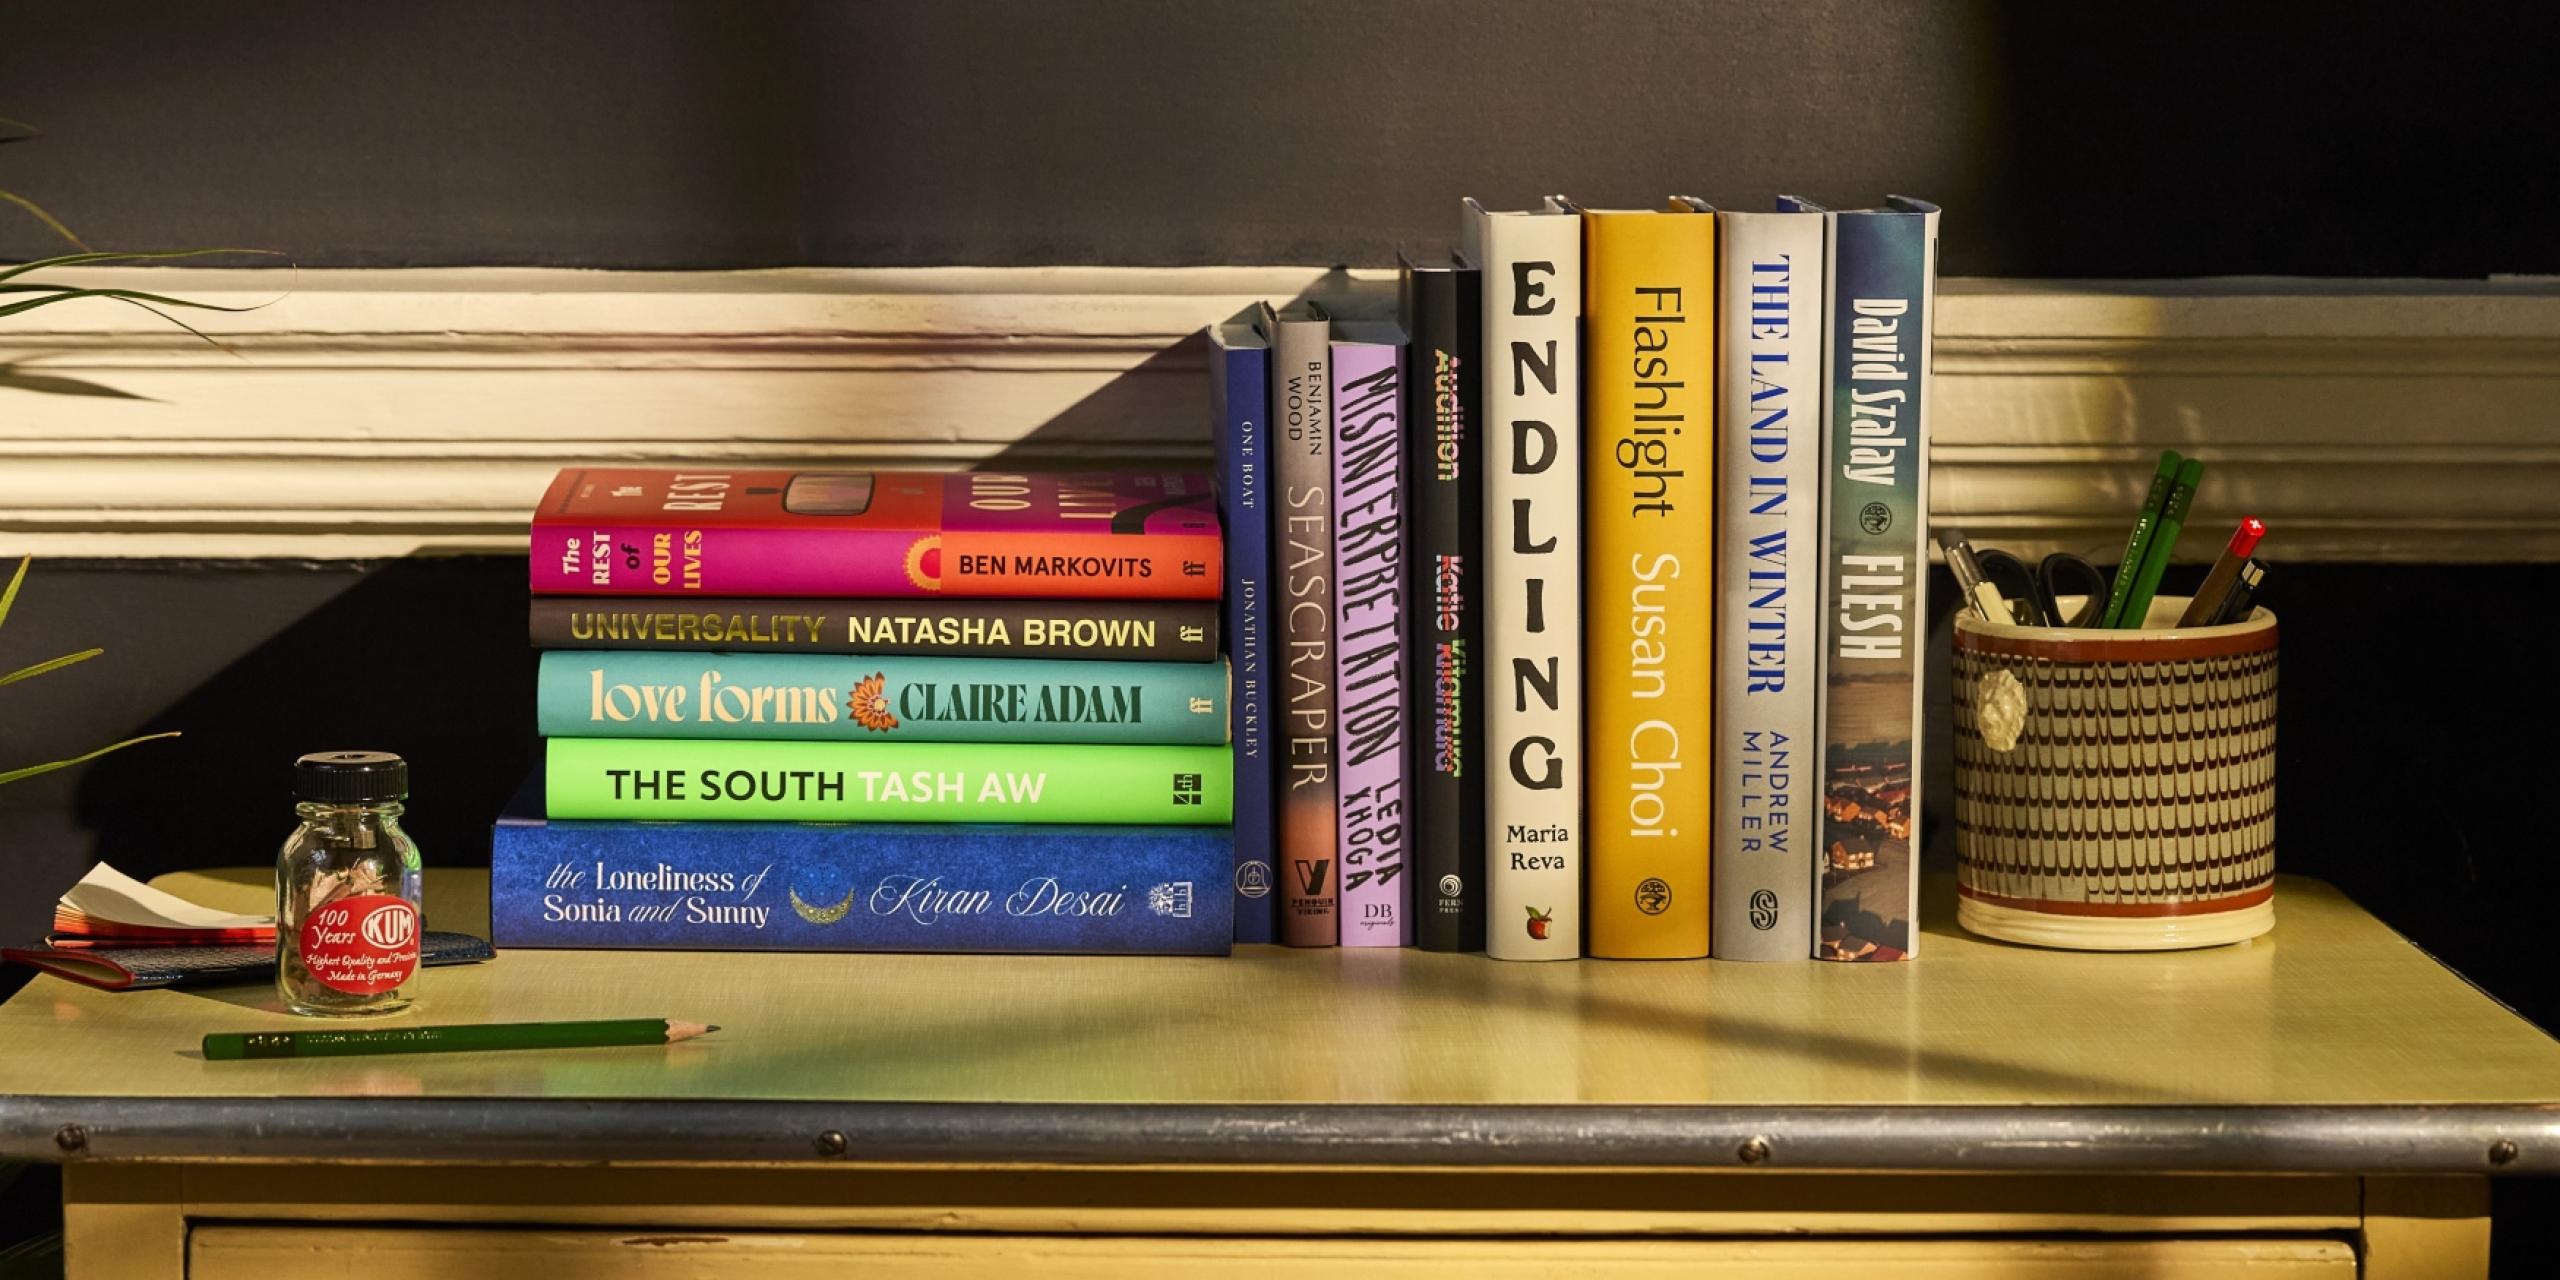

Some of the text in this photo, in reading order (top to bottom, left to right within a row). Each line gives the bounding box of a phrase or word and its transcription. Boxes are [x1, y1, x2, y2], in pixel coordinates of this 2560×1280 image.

[1288, 376, 1302, 441] WOOD
[1308, 361, 1322, 456] BENJAMIN
[1241, 420, 1255, 508] ONE BOAT
[1747, 254, 1790, 697] THE LAND IN WINTER
[1839, 299, 1909, 659] David Szalay FLESH
[662, 474, 731, 511] REST
[1509, 260, 1563, 790] ENDLING
[562, 538, 580, 574] The
[592, 531, 611, 585] REST
[621, 543, 640, 570] of
[653, 533, 671, 585] OUR
[684, 530, 702, 589] LIVES
[959, 555, 1152, 577] BEN MARKOVITS
[1338, 366, 1402, 767] MISINTERPRETATION
[1434, 348, 1467, 778] Audition Katie Kitamura
[1616, 287, 1686, 837] Flashlight Susan Choi
[571, 612, 1156, 647] UNIVERSALITY NATASHA BROWN
[1287, 486, 1328, 791] SEASCRAPER
[1241, 578, 1258, 758] JONATHAN BUCKLEY
[590, 669, 838, 724] love forms
[900, 682, 1143, 724] CLAIRE ADAM
[606, 769, 1046, 804] THE SOUTH TASH AW
[1741, 731, 1762, 853] MILLER
[1769, 730, 1790, 853] ANDREW
[1343, 786, 1374, 892] XHOGA
[1374, 778, 1403, 886] LEDIA
[1506, 825, 1569, 843] Maria
[545, 861, 775, 902] the Loneliness of
[1510, 852, 1565, 870] Reva
[318, 909, 349, 927] 100
[543, 894, 770, 929] Sonia and Sunny
[869, 874, 1128, 926] Kiran Desai
[1364, 903, 1392, 918] DB
[312, 925, 356, 949] Years
[366, 909, 411, 944] KUM
[306, 953, 341, 971] Highest
[341, 954, 375, 969] Quality
[376, 952, 391, 965] and
[326, 969, 403, 985] Made in Germany
